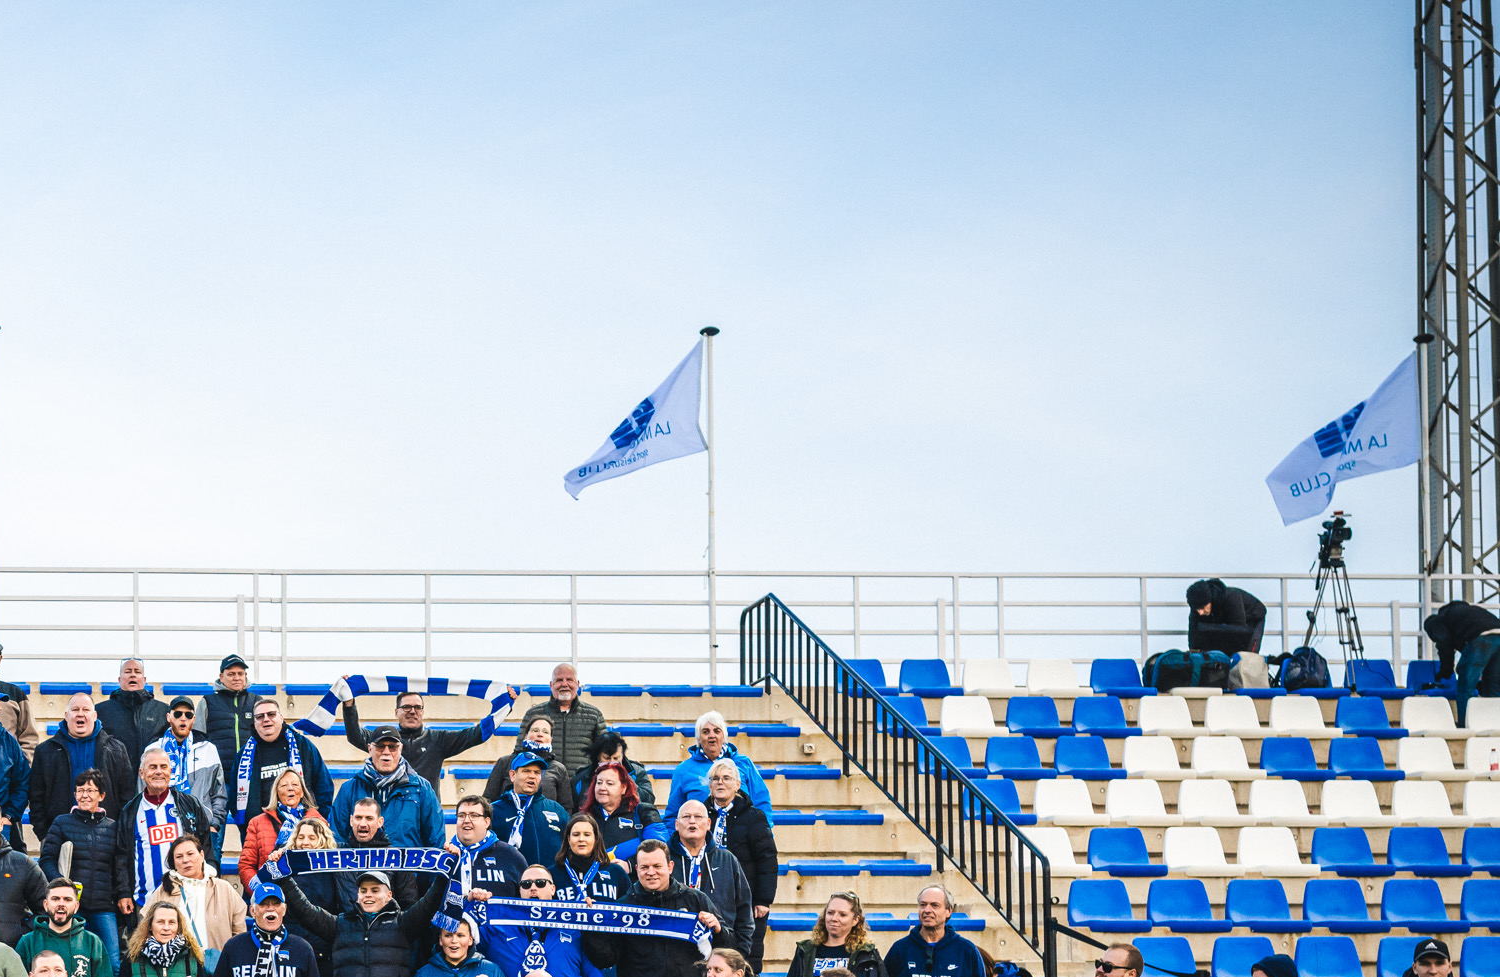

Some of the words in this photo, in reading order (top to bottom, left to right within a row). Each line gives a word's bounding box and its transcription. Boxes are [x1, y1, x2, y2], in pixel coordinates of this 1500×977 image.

[152, 826, 174, 842] DB
[307, 849, 403, 870] HERTHA
[404, 850, 457, 874] BSC
[476, 869, 506, 883] LIN
[556, 882, 617, 902] BELIN
[530, 906, 604, 924] Szene
[526, 955, 544, 966] SZ
